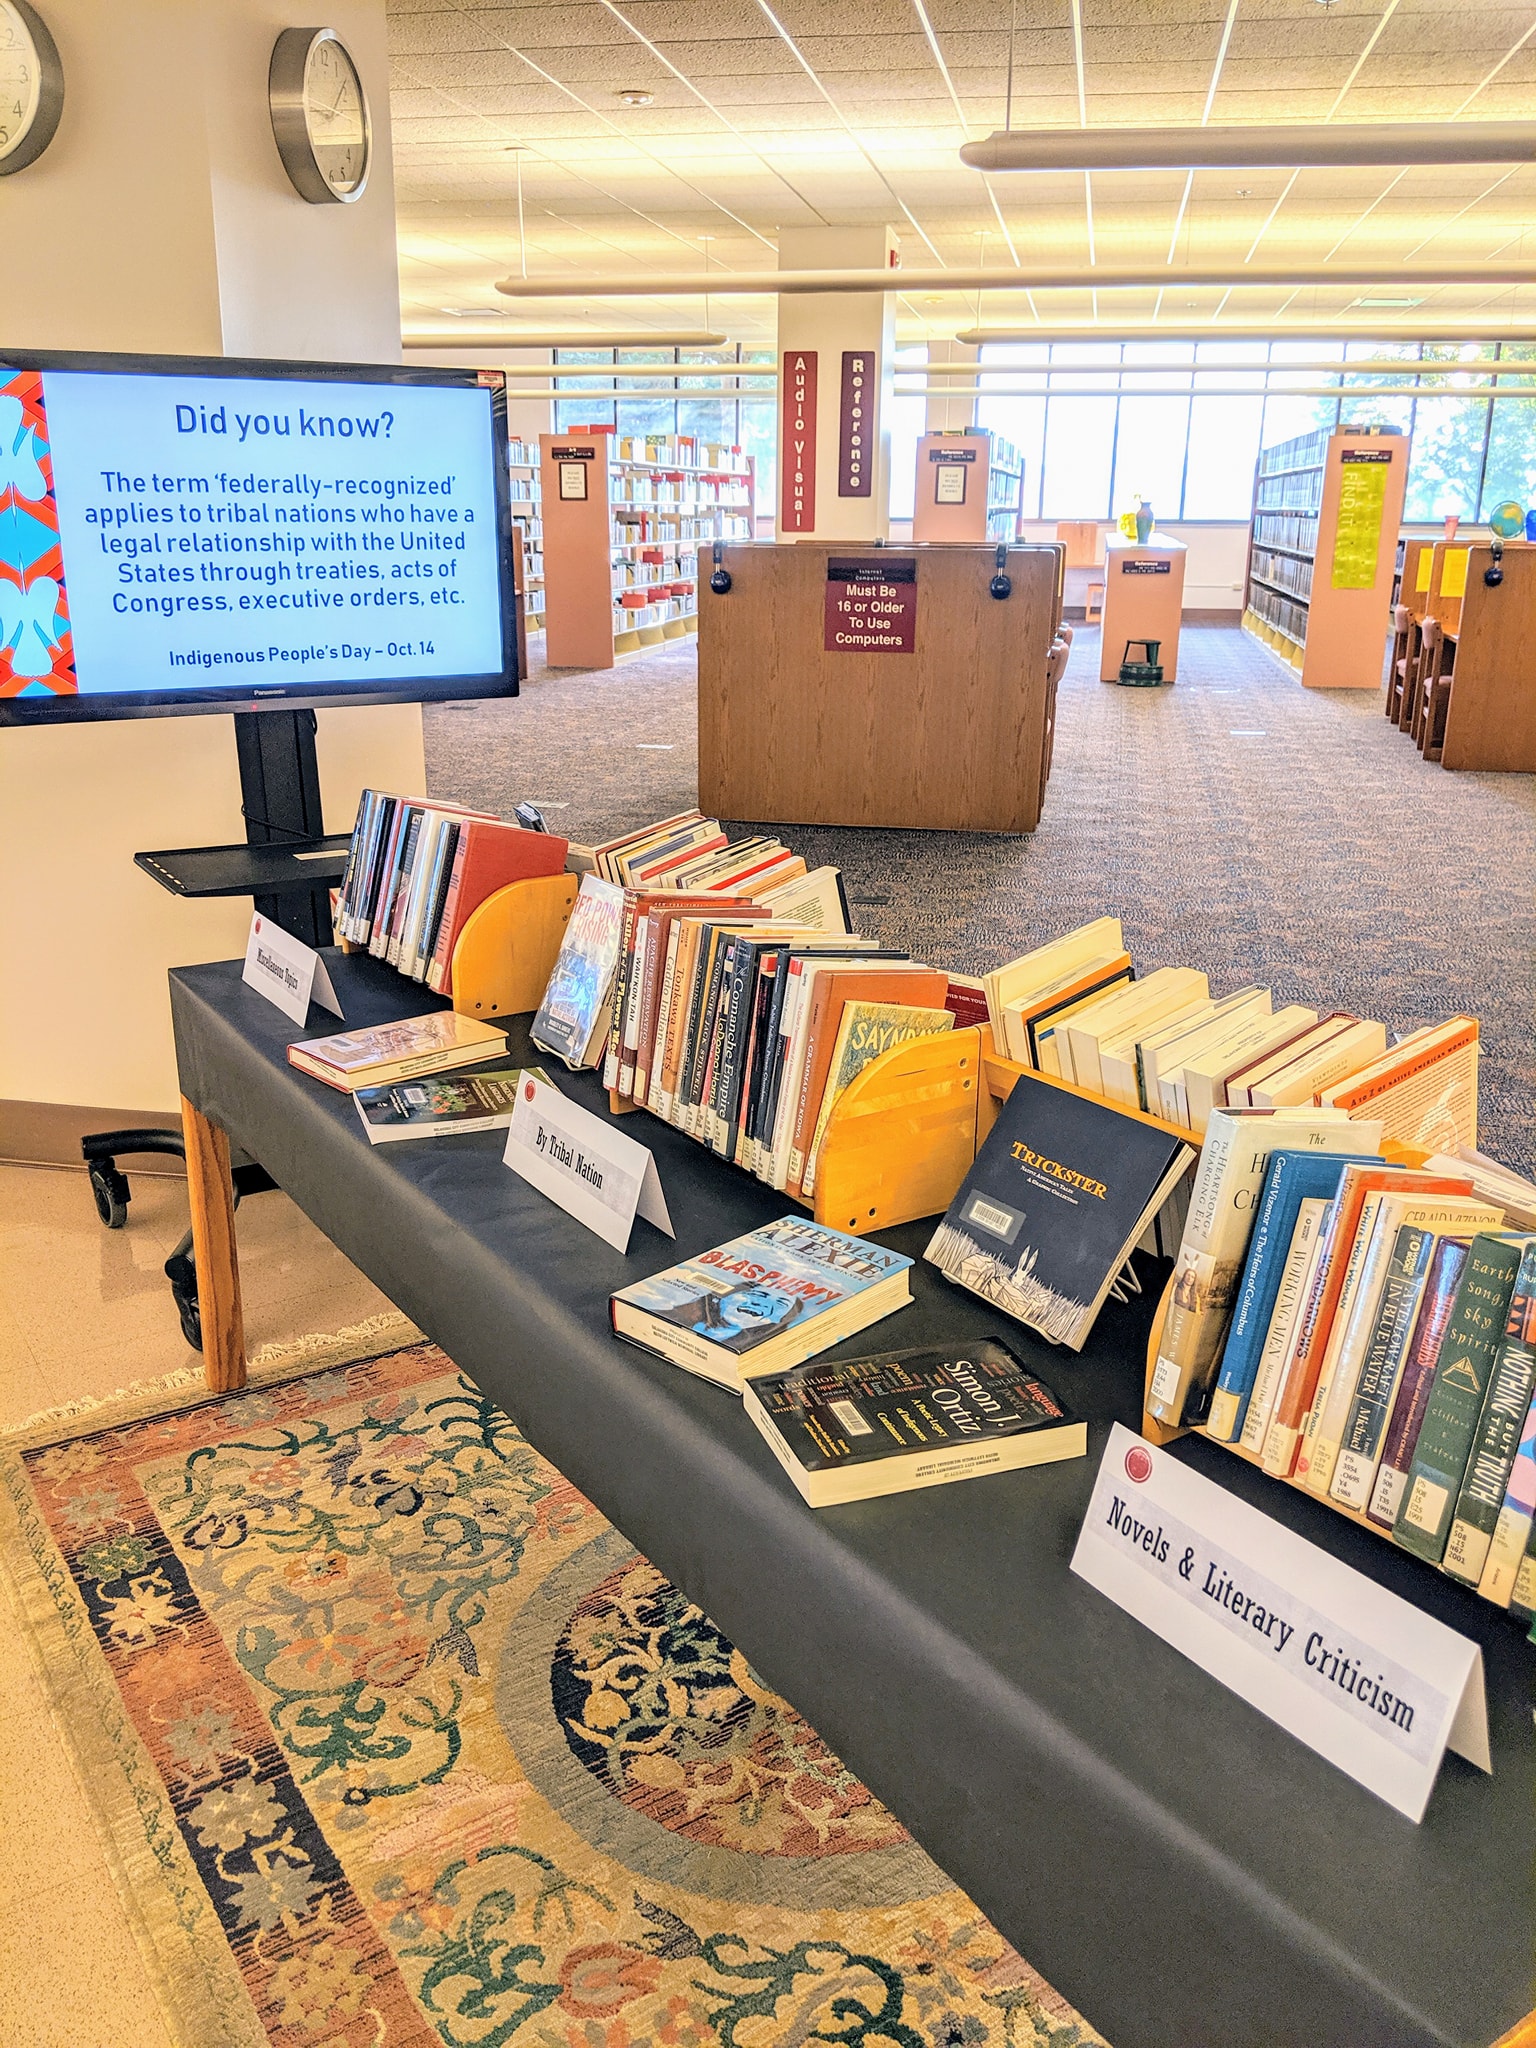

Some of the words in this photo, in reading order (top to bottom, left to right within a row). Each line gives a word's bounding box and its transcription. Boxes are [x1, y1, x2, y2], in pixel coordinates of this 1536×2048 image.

[19, 64, 29, 84] 3
[12, 99, 24, 118] 4
[795, 357, 806, 430] Audio
[174, 403, 228, 436] Did
[235, 412, 291, 443] you
[299, 409, 395, 438] know?
[850, 359, 864, 487] Reference
[100, 471, 146, 494] The
[152, 473, 209, 494] term
[794, 440, 805, 527] Visual
[1343, 472, 1358, 509] FIND
[84, 504, 175, 529] applies
[179, 505, 202, 523] to
[207, 503, 269, 523] tribal
[275, 504, 357, 523] nations
[361, 505, 406, 523] who
[410, 504, 458, 523] have
[462, 508, 475, 523] a
[100, 532, 161, 558] legal
[167, 532, 305, 556] relationship
[311, 532, 358, 552] with
[363, 532, 396, 551] the
[400, 531, 466, 551] United
[118, 562, 196, 583] States
[200, 562, 291, 586] through
[296, 560, 385, 582] treaties,
[391, 559, 435, 579] acts
[439, 559, 458, 578] of
[846, 584, 876, 596] Must
[880, 585, 896, 597] Be
[112, 591, 233, 618] Congress,
[239, 589, 344, 610] executive
[350, 587, 425, 608] orders,
[430, 586, 466, 605] etc.
[838, 601, 851, 612] 16
[854, 603, 867, 612] or
[871, 601, 904, 613] Older
[836, 632, 903, 647] Computers
[849, 617, 863, 628] To
[867, 617, 891, 629] Use
[169, 649, 265, 669] Indigenous
[269, 645, 339, 664] People's
[342, 643, 371, 662] Day
[387, 641, 419, 658] Oct.
[420, 641, 435, 656] 14
[622, 912, 634, 958] Killers
[257, 947, 284, 979] Miscellaneous
[284, 968, 298, 990] Topics
[649, 937, 657, 978] APACHE
[662, 956, 675, 996] Caddo
[613, 980, 627, 1029] Flower
[670, 968, 685, 1025] Tonkawa
[692, 964, 703, 1008] NAMING
[707, 961, 721, 1017] COMANCHE
[641, 979, 654, 1048] RESERVATION
[657, 999, 669, 1046] Indians
[689, 1012, 697, 1033] THE
[701, 1020, 711, 1045] JACK
[727, 977, 744, 1058] Comanche
[663, 1026, 676, 1070] TEXTS
[683, 1037, 692, 1076] WORLD
[709, 1070, 721, 1105] Harris
[801, 1045, 813, 1092] GRAMMAR
[718, 1061, 734, 1118] Empire
[799, 1093, 807, 1106] OF
[795, 1107, 805, 1139] KIOWA
[1309, 1133, 1326, 1145] The
[535, 1126, 548, 1152] By
[549, 1135, 575, 1168] Tribal
[575, 1153, 603, 1190] Nation
[1010, 1140, 1109, 1200] TRICKSTER
[1199, 1139, 1221, 1206] CHARGING
[1271, 1156, 1286, 1188] Gerald
[1203, 1155, 1228, 1233] HEARTSONG
[1262, 1189, 1280, 1226] Vizenor
[1358, 1205, 1373, 1237] WHITE
[753, 1227, 885, 1280] ALEXIE
[774, 1220, 902, 1268] SHERMAN
[1256, 1235, 1268, 1254] The
[1351, 1240, 1365, 1267] WOLF
[697, 1251, 843, 1307] BLASPHEMY
[1247, 1279, 1256, 1290] of
[1249, 1254, 1265, 1280] Heirs
[1278, 1250, 1307, 1320] WORKING
[1472, 1258, 1514, 1283] Earth
[1297, 1254, 1333, 1359] WORDARROWS
[1340, 1270, 1357, 1310] WOMAN
[1388, 1283, 1402, 1302] IN
[1403, 1287, 1414, 1298] A
[1236, 1289, 1254, 1336] Columbus
[1377, 1303, 1397, 1342] BLUE
[1388, 1301, 1412, 1358] YELLOW
[1269, 1323, 1287, 1359] MEN
[778, 1371, 851, 1390] traditional
[886, 1362, 913, 1386] poem
[1362, 1345, 1387, 1394] WATER
[1377, 1360, 1395, 1399] RAFT
[1490, 1344, 1536, 1420] NOTHING
[931, 1388, 982, 1434] Ortiz
[944, 1360, 1001, 1413] Simon
[985, 1413, 1021, 1427] J.
[1025, 1382, 1064, 1418] language
[1350, 1407, 1371, 1450] Michael
[1485, 1416, 1501, 1447] THE
[1501, 1420, 1515, 1455] BUT
[1468, 1448, 1512, 1506] TRUTH
[1453, 1530, 1467, 1541] 508
[1456, 1524, 1465, 1532] PS
[1448, 1553, 1465, 1564] 2001
[1106, 1495, 1171, 1564] Novels
[1178, 1546, 1195, 1580] &
[1201, 1560, 1295, 1654] Literary
[1303, 1631, 1415, 1733] Criticism
